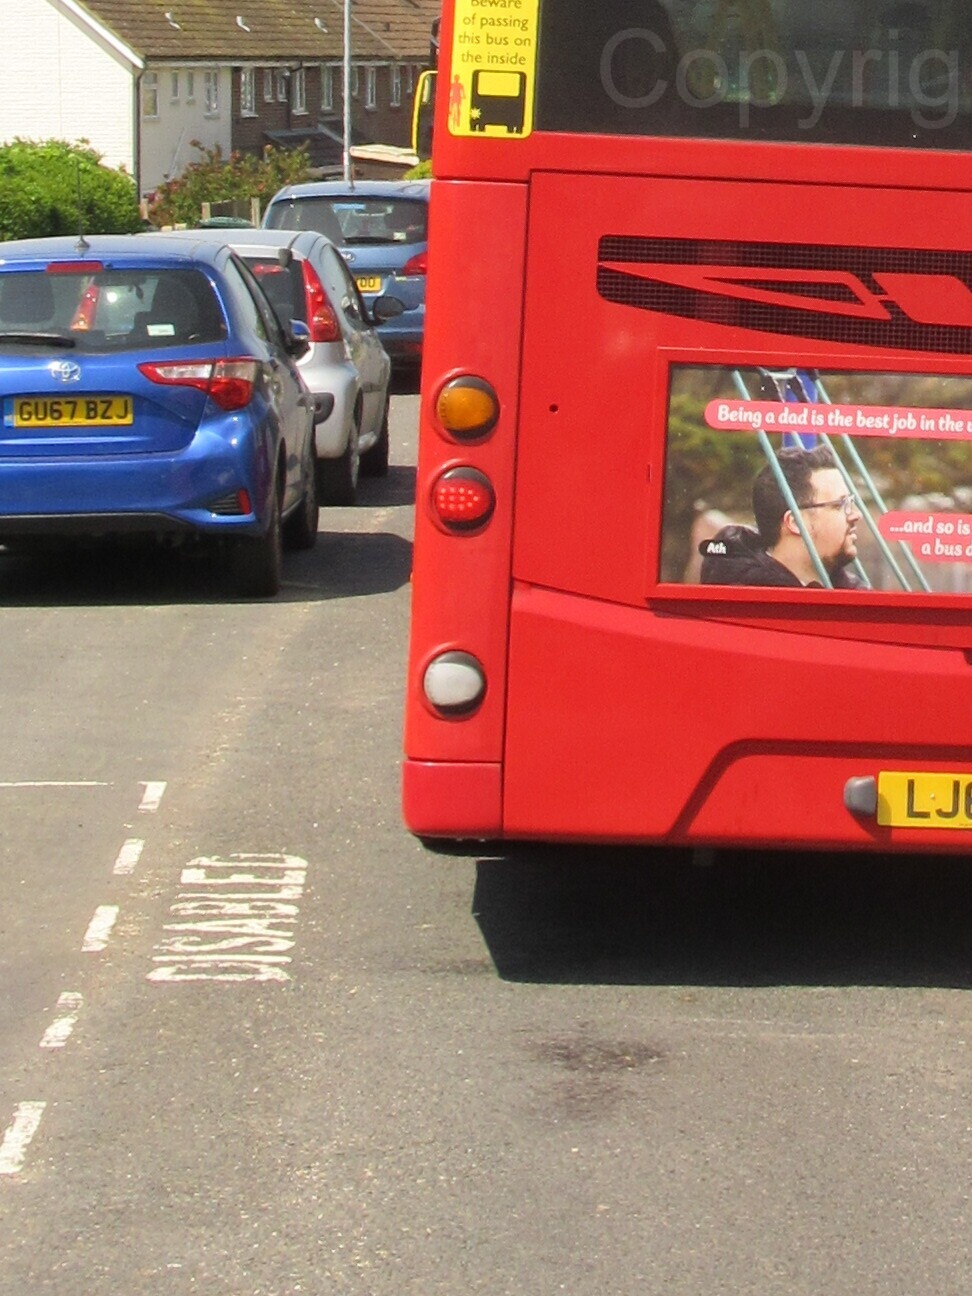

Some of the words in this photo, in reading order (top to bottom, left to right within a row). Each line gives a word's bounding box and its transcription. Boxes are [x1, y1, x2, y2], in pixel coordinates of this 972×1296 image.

[462, 12, 477, 26] of
[480, 15, 529, 32] passing
[458, 31, 481, 45] this
[486, 32, 509, 46] bus
[514, 37, 532, 47] on
[461, 50, 482, 64] the
[487, 51, 527, 66] inside
[19, 401, 79, 421] GU67
[85, 399, 129, 420] BZJ
[717, 404, 763, 428] Being
[765, 411, 776, 424] a
[778, 406, 808, 426] dad
[811, 409, 825, 426] is
[827, 408, 853, 427] the
[856, 410, 890, 429] best
[889, 412, 917, 435] job
[920, 414, 935, 432] in
[938, 413, 964, 433] the
[936, 520, 954, 535] so
[957, 519, 970, 535] is
[921, 542, 932, 555] a
[934, 538, 963, 557] bus
